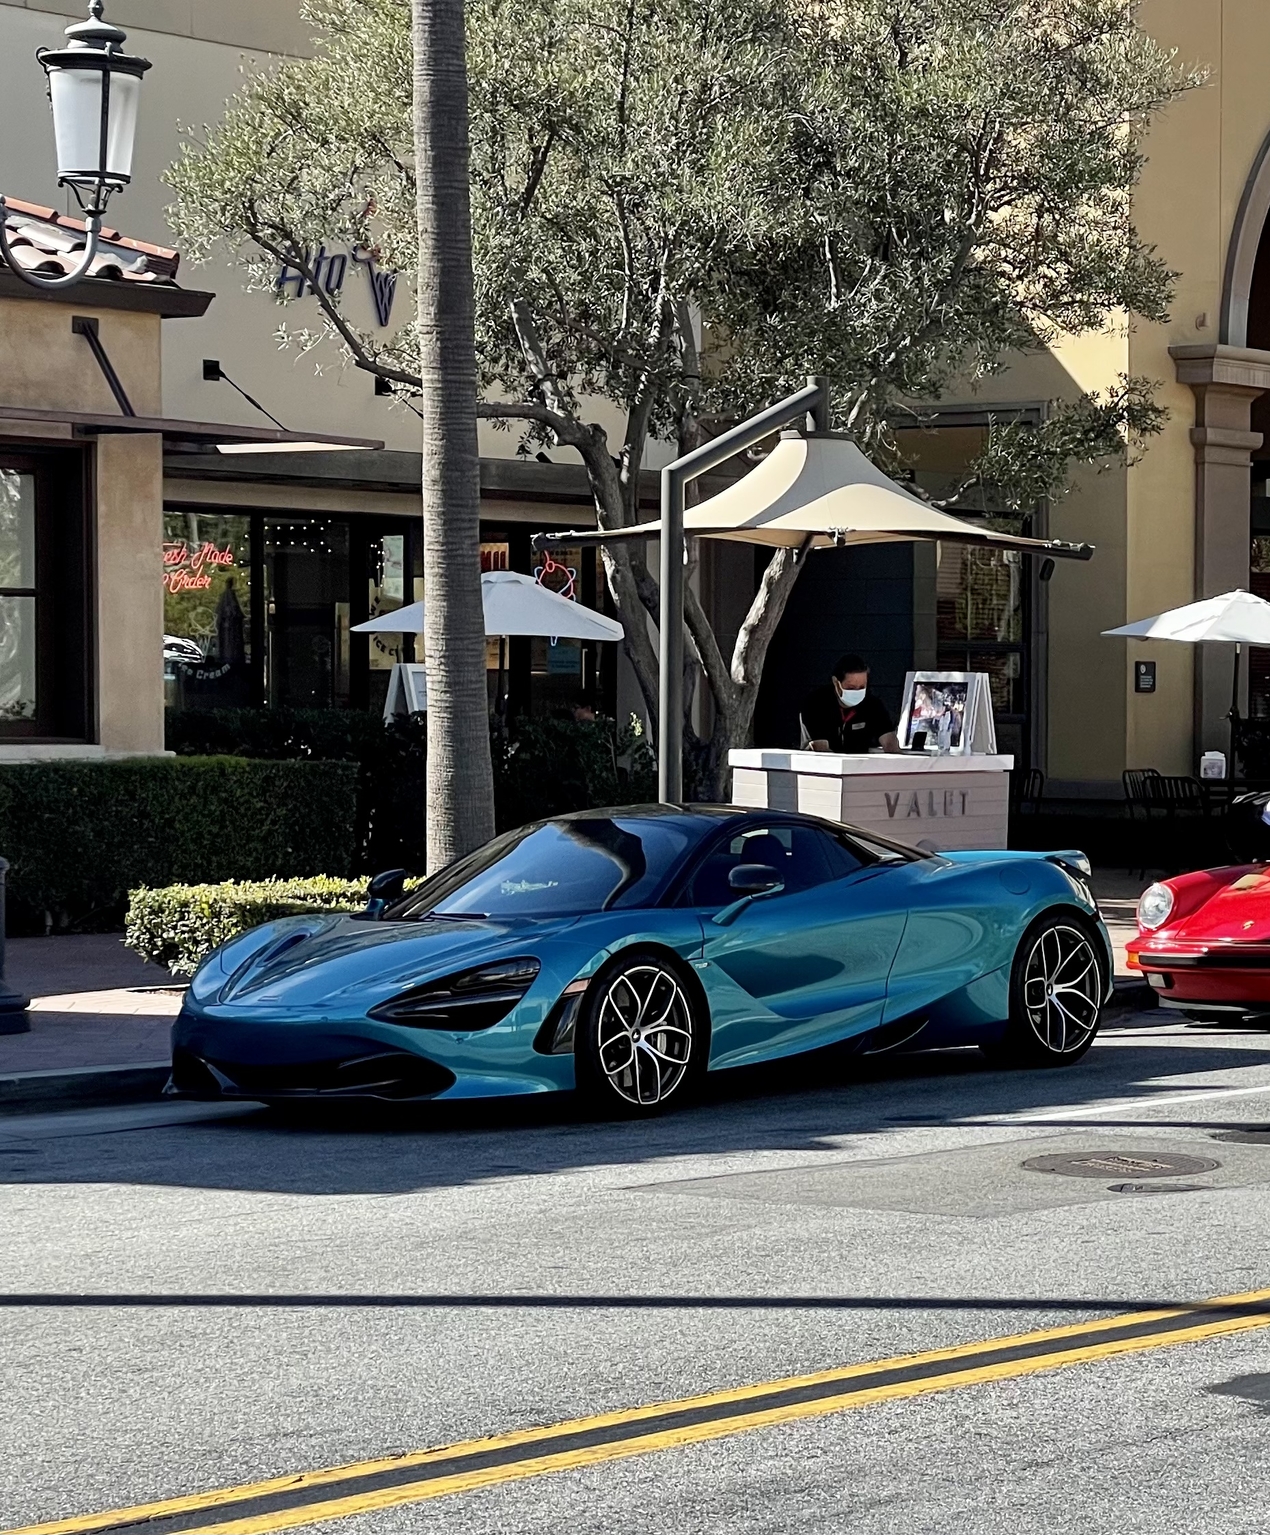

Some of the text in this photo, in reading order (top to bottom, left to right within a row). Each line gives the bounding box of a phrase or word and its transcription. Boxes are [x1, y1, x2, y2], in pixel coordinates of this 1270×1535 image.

[191, 541, 233, 569] Made
[169, 565, 211, 593] Order
[884, 790, 969, 818] VALET
